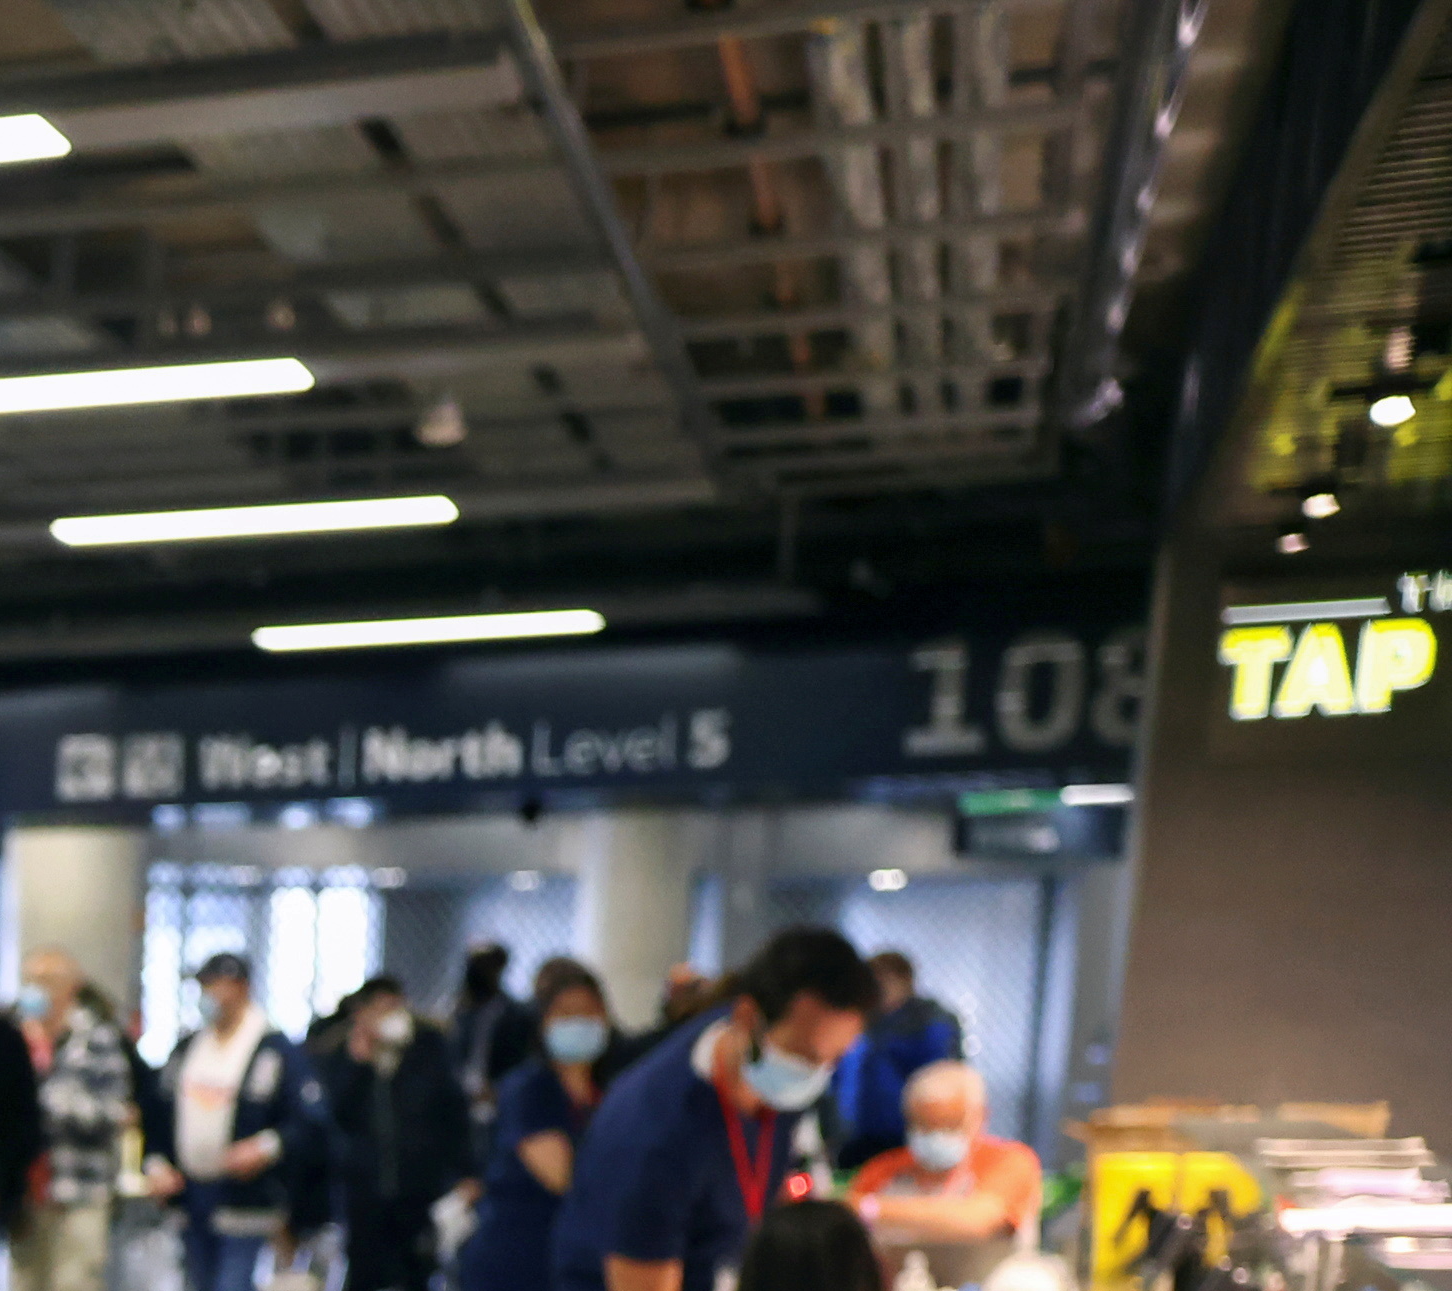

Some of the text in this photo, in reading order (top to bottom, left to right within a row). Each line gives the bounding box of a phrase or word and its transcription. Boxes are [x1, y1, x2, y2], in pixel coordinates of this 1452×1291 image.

[1217, 617, 1438, 721] TAP
[199, 733, 331, 788] West
[362, 720, 523, 784] North
[532, 711, 678, 777] Level
